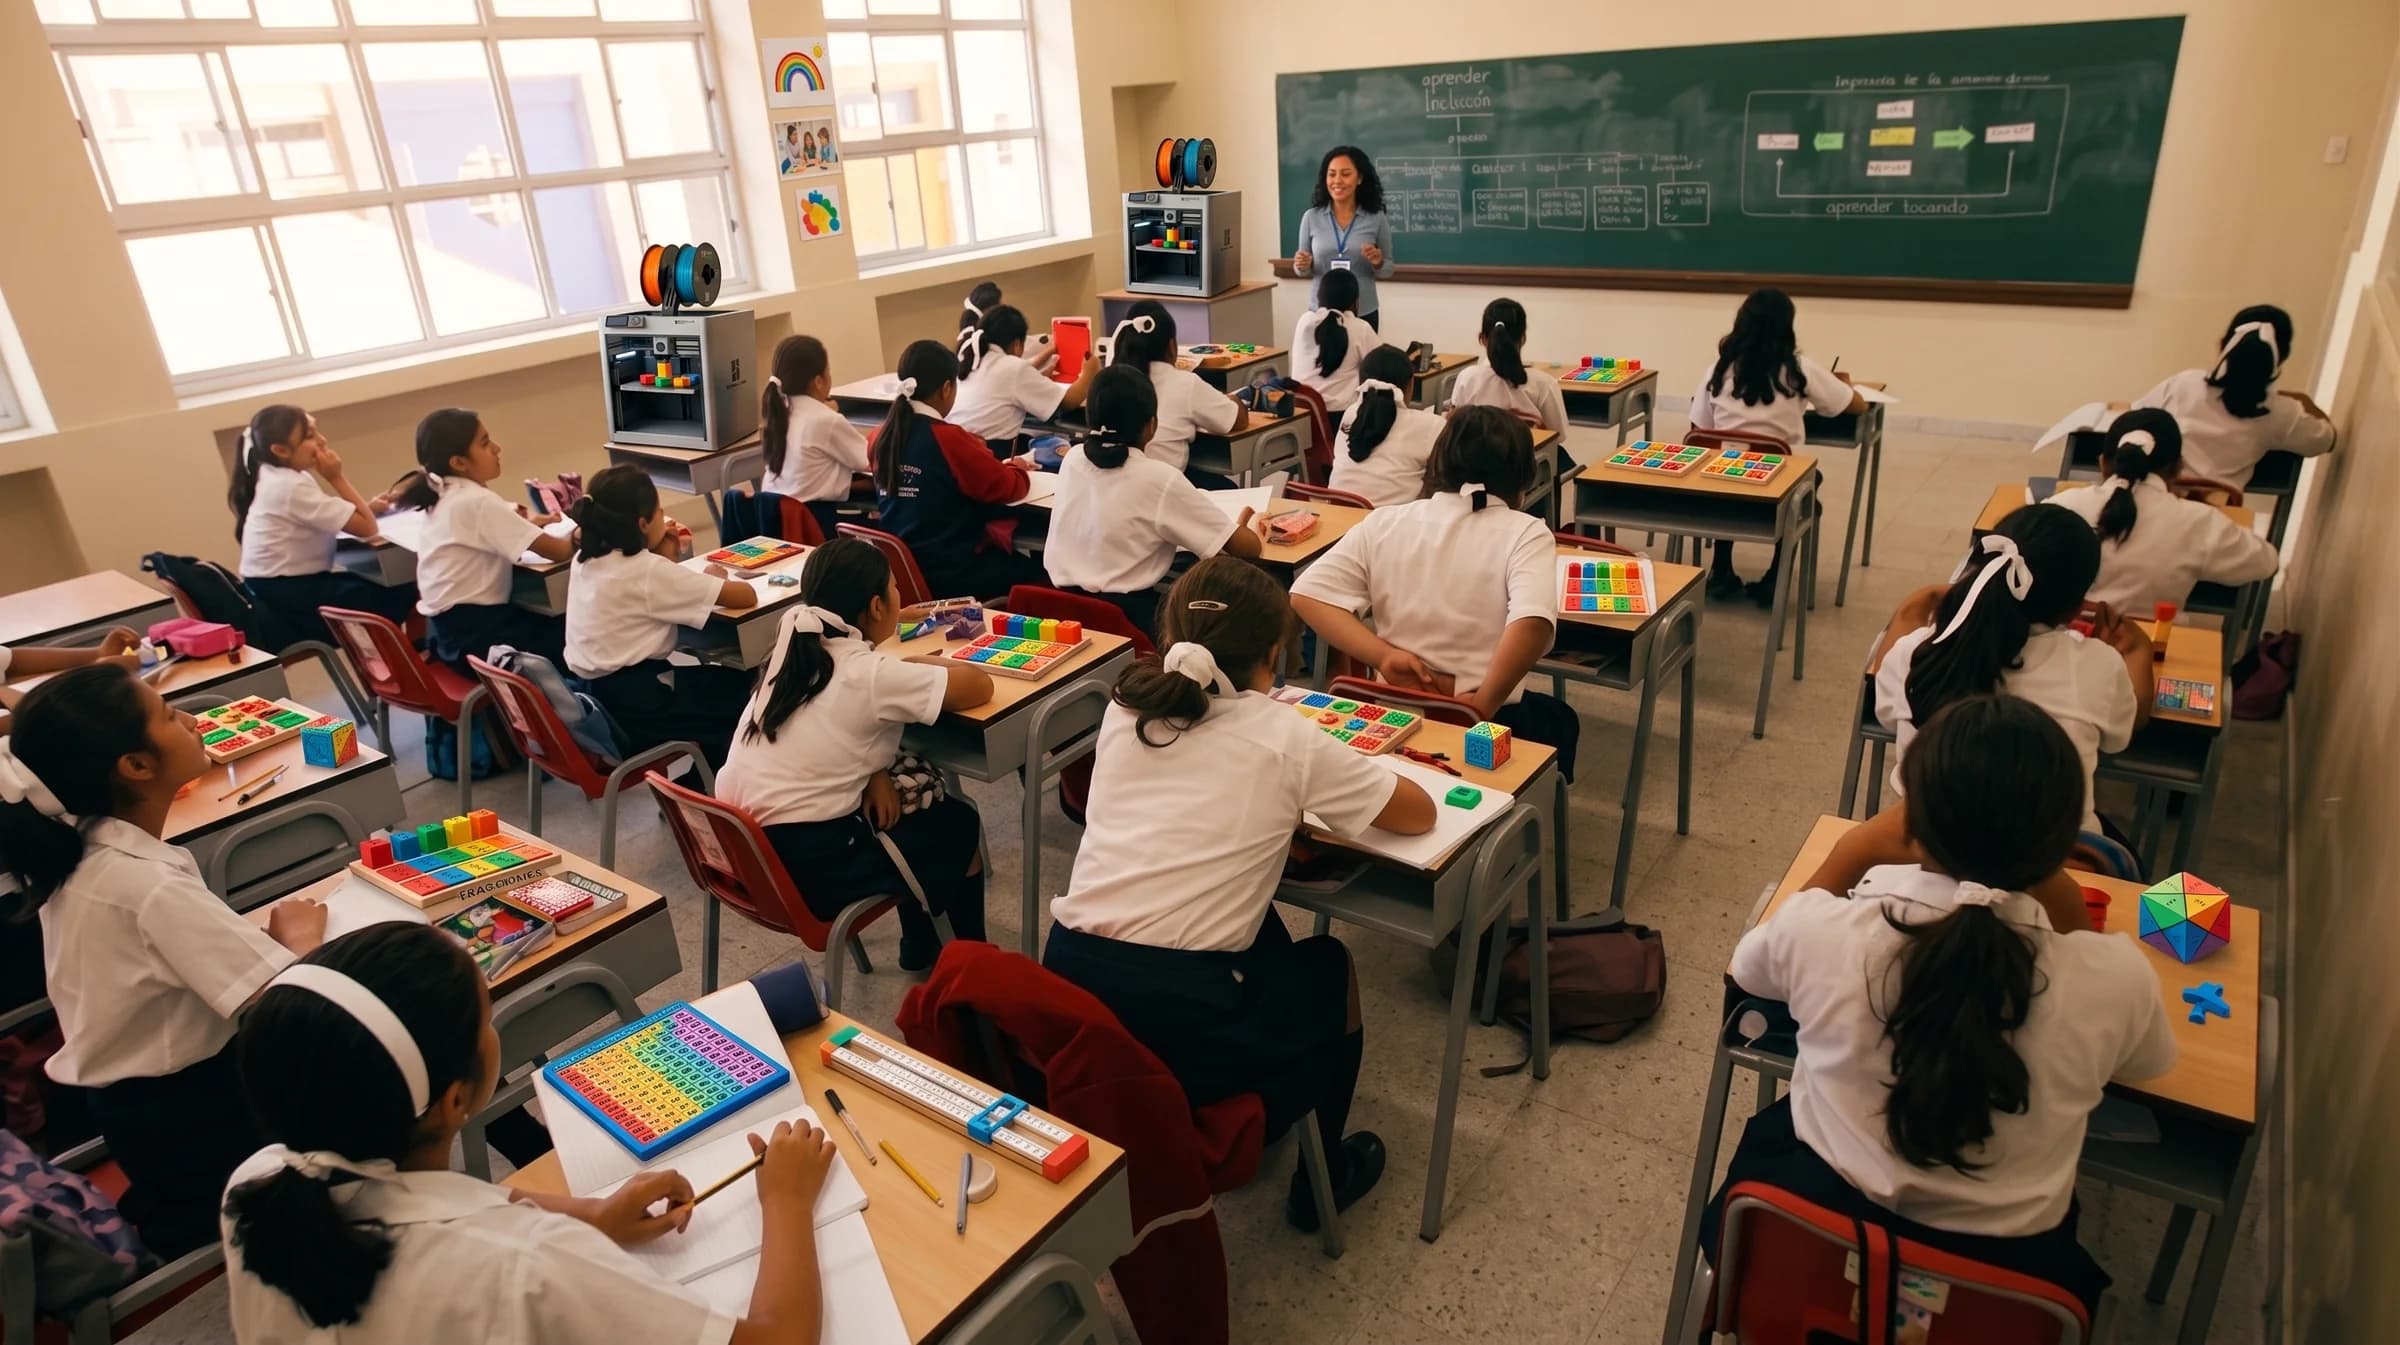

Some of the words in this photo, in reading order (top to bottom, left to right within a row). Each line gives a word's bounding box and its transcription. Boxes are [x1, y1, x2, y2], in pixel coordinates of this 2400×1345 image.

[1422, 65, 1491, 95] aprender
[1826, 197, 1893, 220] aprender
[1904, 198, 1969, 214] tocando
